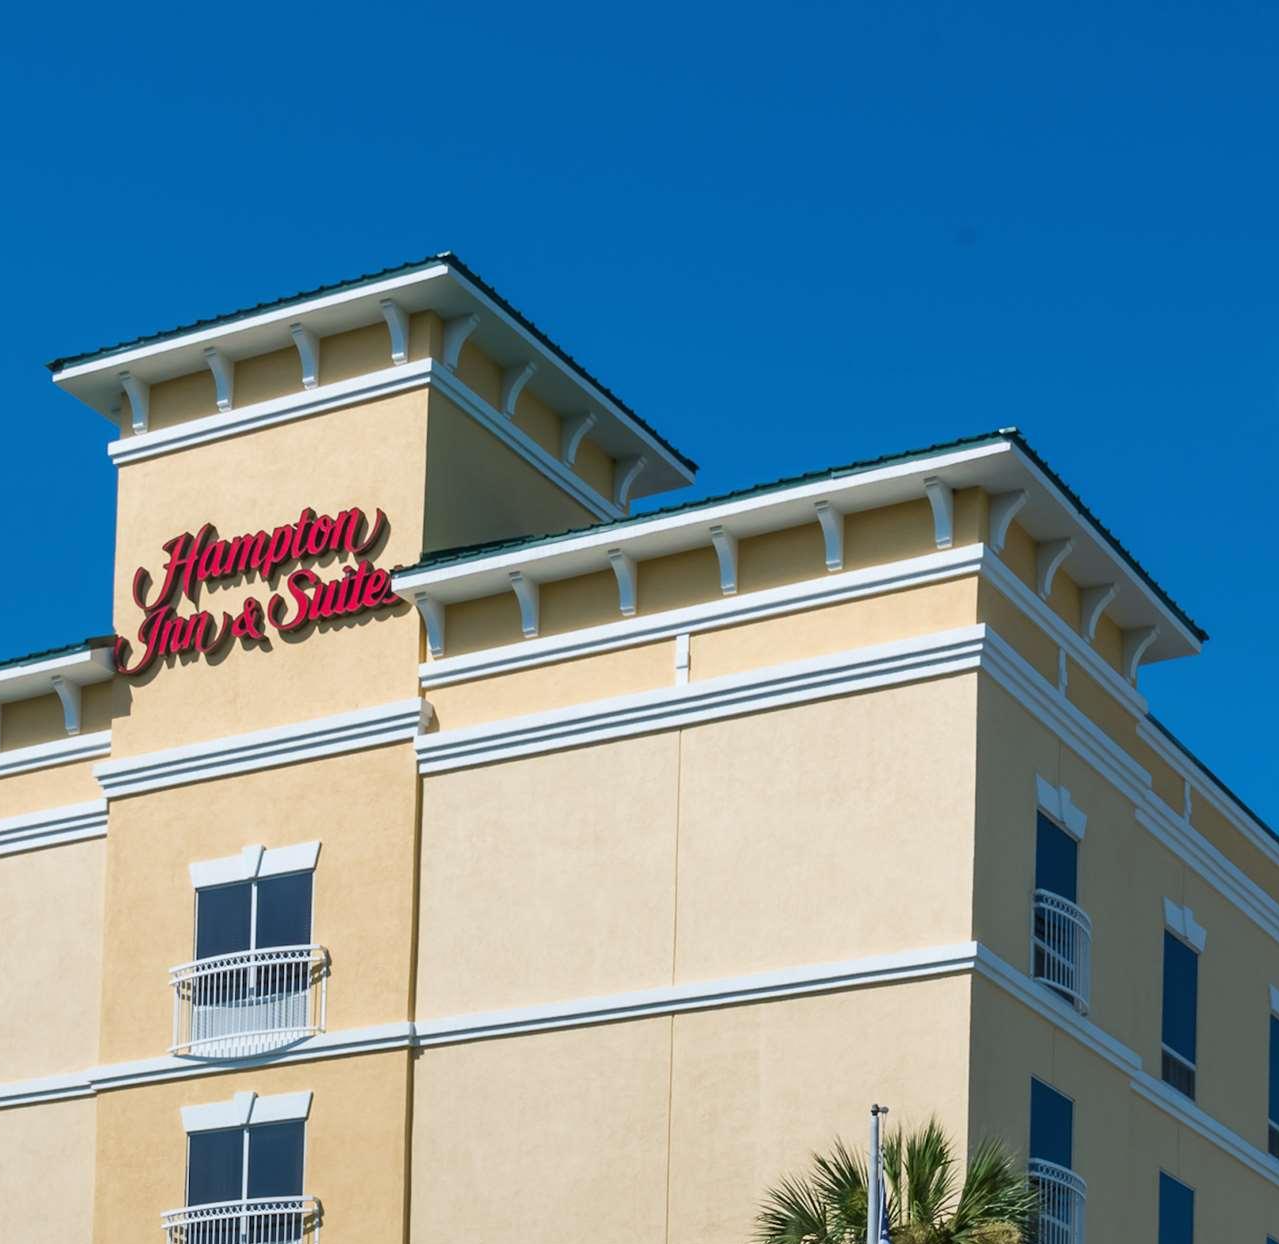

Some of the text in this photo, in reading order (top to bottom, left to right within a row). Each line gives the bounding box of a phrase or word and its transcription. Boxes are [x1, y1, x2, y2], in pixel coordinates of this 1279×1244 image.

[132, 506, 388, 611] Hampton
[115, 605, 229, 676] Inn
[231, 596, 265, 641] &
